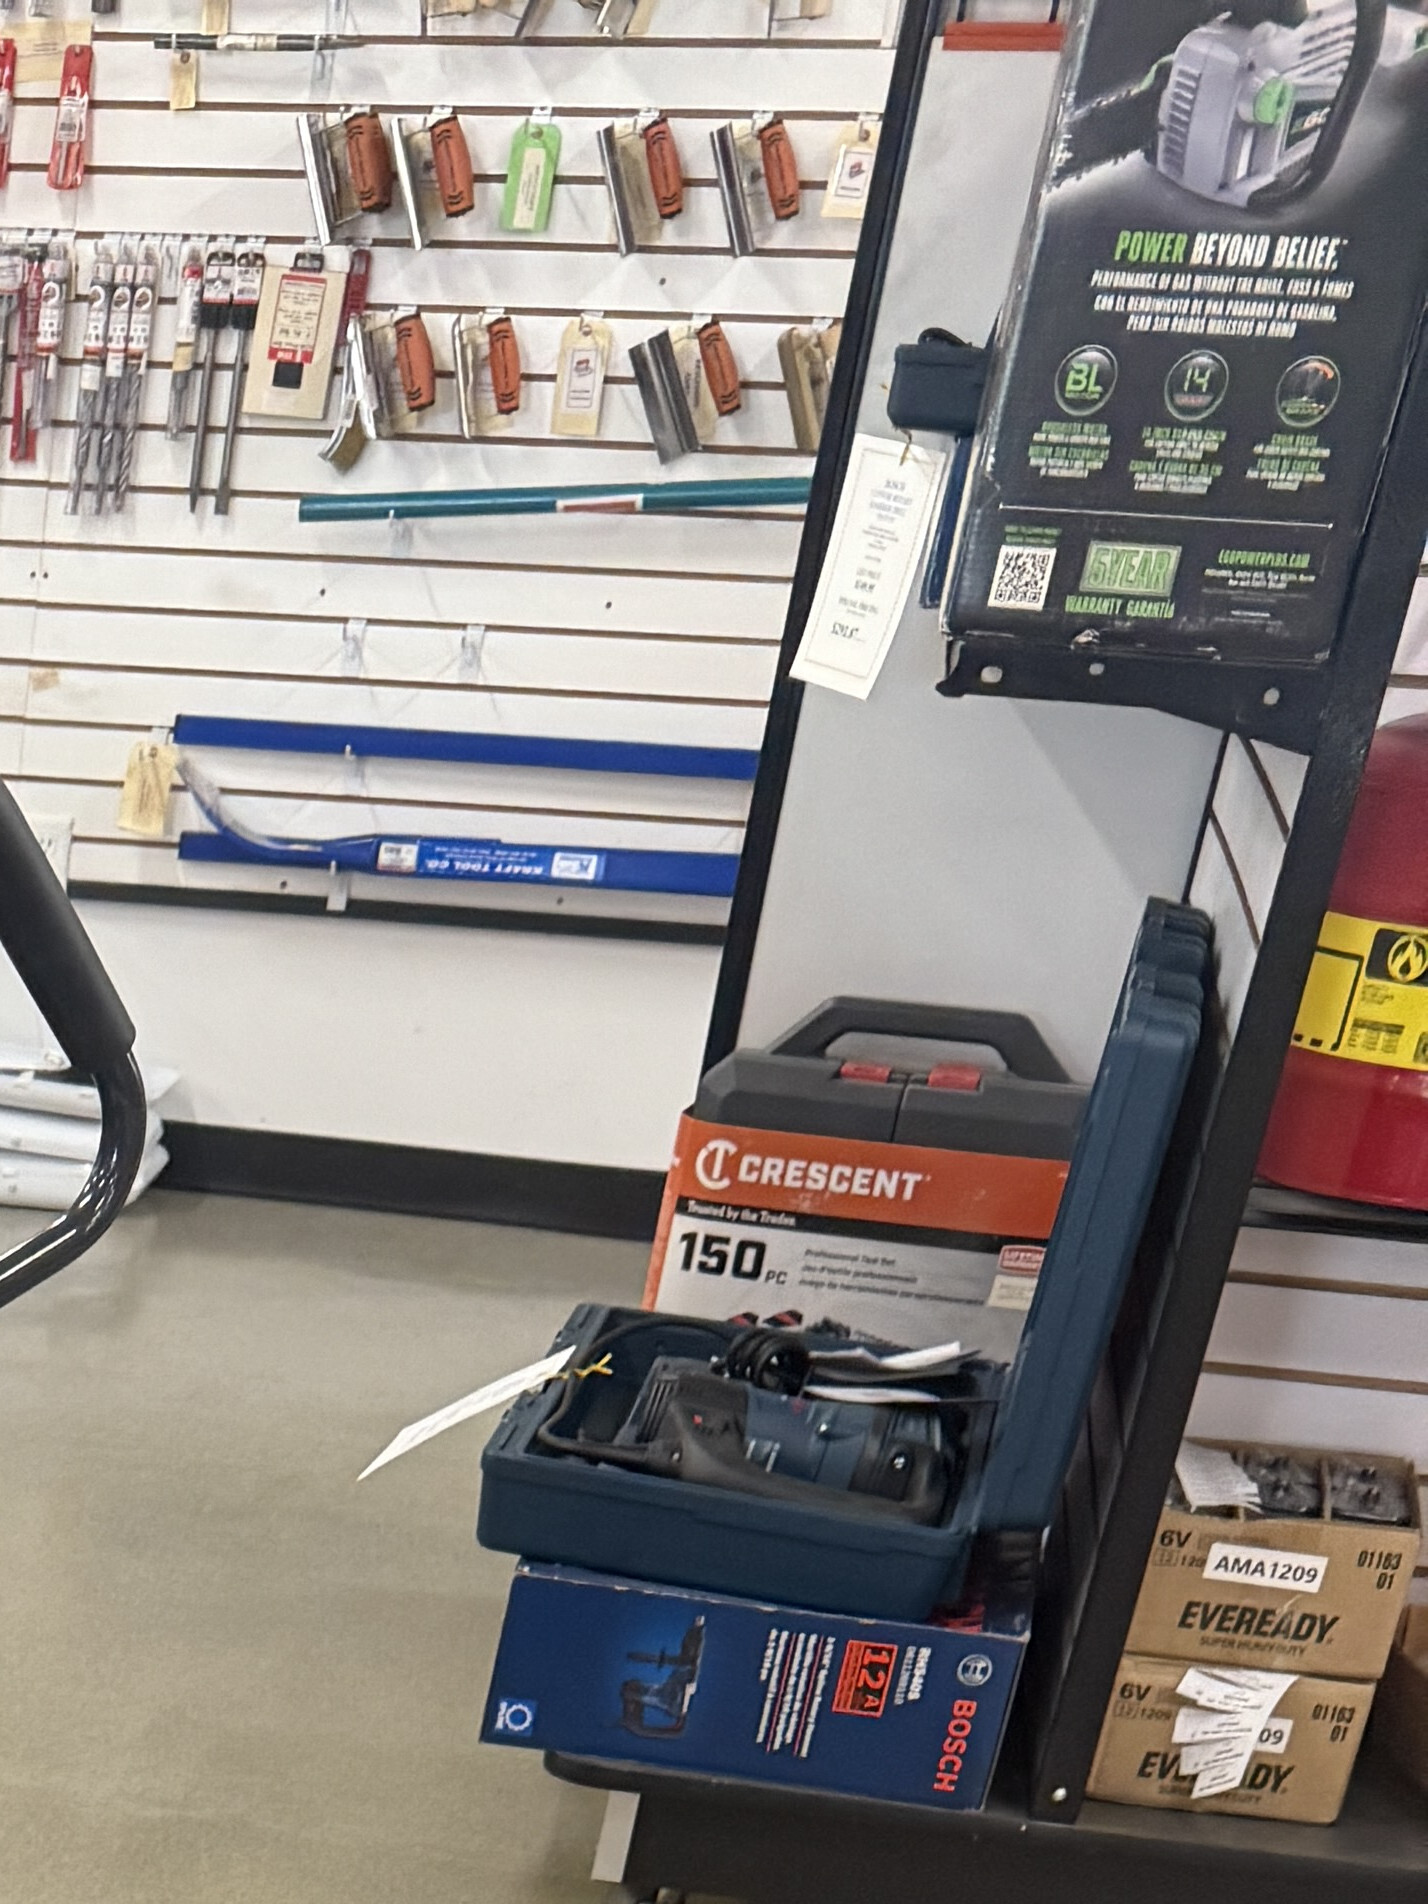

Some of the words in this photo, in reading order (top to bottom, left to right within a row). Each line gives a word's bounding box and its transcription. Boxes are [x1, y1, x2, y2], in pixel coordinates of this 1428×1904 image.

[1114, 230, 1188, 263] POWER
[1190, 232, 1271, 267] BEYOND
[1091, 270, 1157, 289] PERFORMANCE
[1159, 273, 1171, 290] OF
[1193, 275, 1236, 293] WITHOUT
[1236, 277, 1252, 293] THE
[1065, 362, 1103, 393] BL
[1183, 368, 1213, 393] 14
[1065, 595, 1122, 615] WARRANTY
[454, 860, 490, 873] TOOL
[495, 863, 543, 876] KRAFT
[738, 1154, 924, 1200] CRESCENT
[687, 1200, 726, 1221] Trusted
[727, 1205, 739, 1222] by
[741, 1207, 759, 1223] the
[761, 1209, 796, 1227] Trades
[679, 1230, 767, 1281] 150
[764, 1269, 789, 1285] PC
[804, 1248, 859, 1265] Professional
[861, 1254, 878, 1266] Tool
[880, 1256, 896, 1267] Set
[1159, 1528, 1193, 1548] 6V
[1213, 1555, 1319, 1584] AMA1209
[1376, 1572, 1395, 1590] 01
[1177, 1600, 1340, 1645] EVEREADY
[1200, 1635, 1236, 1649] SUPER
[1237, 1639, 1275, 1652] HEAVY
[1275, 1643, 1307, 1657] DUTY
[1119, 1682, 1151, 1701] 6V
[1330, 1726, 1348, 1742] 01
[933, 1700, 977, 1792] BOSCH
